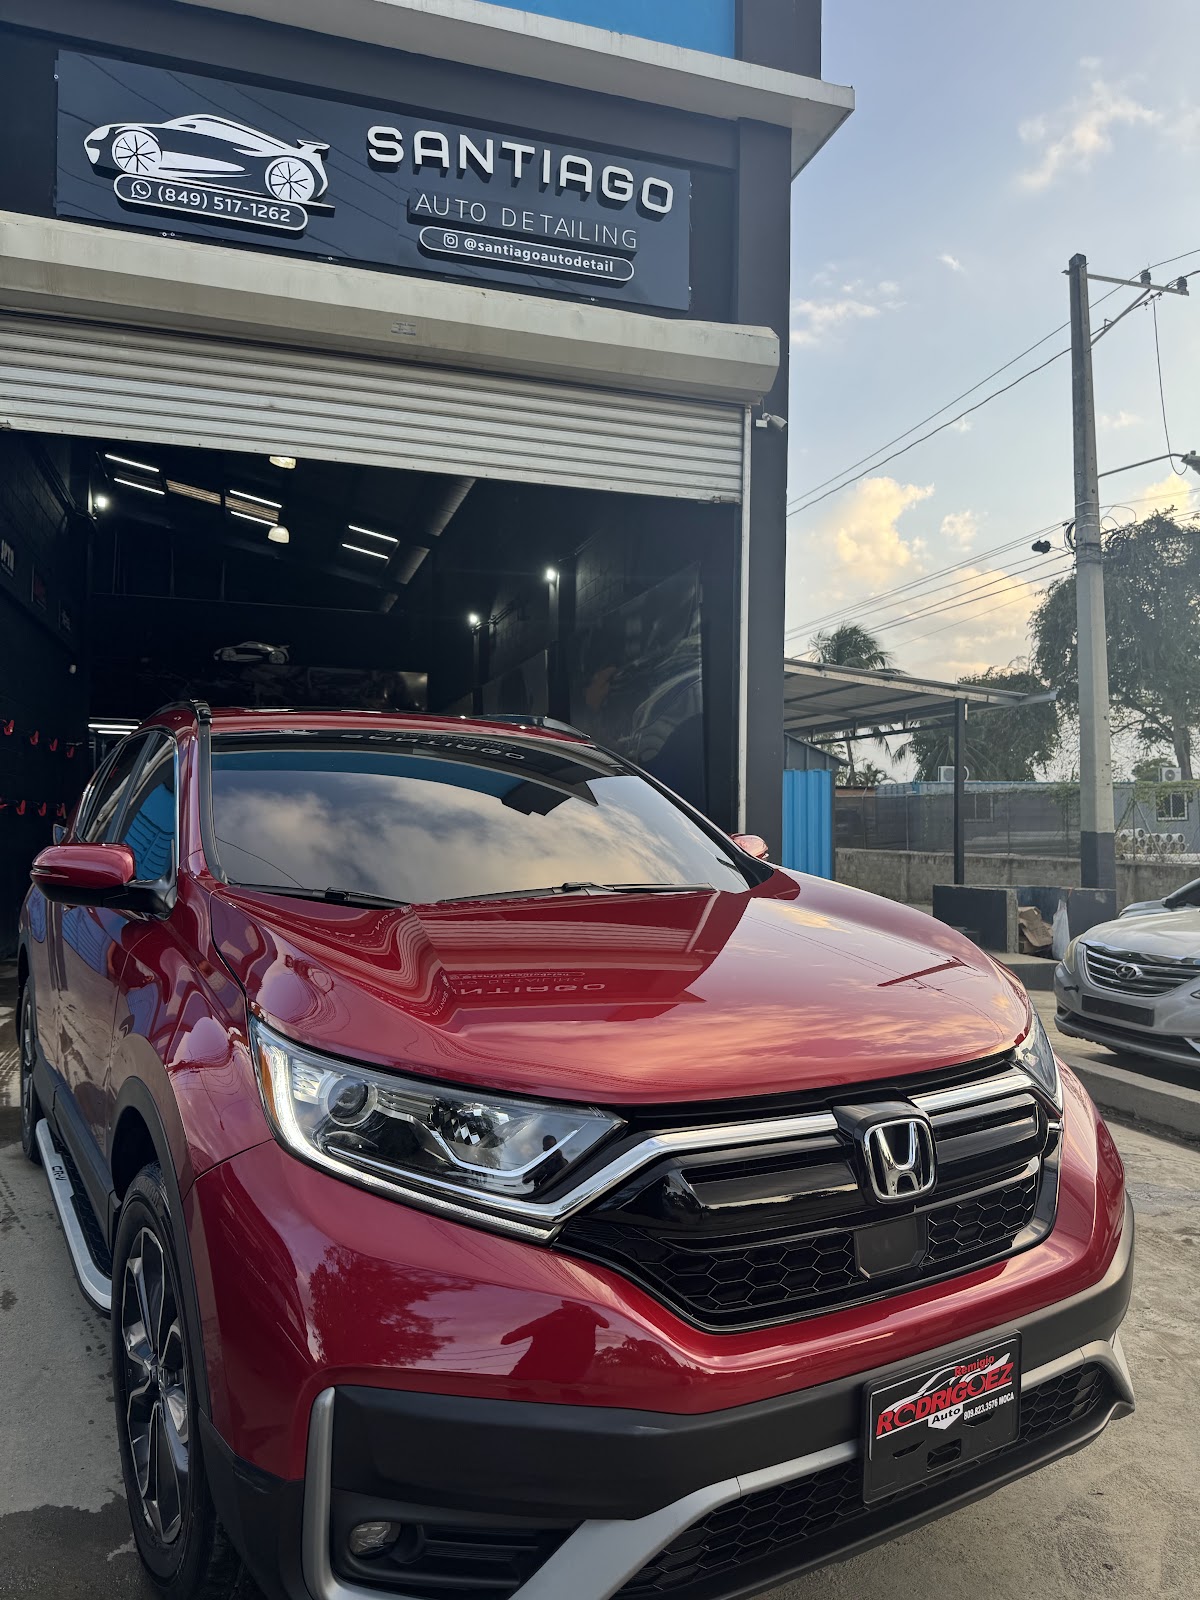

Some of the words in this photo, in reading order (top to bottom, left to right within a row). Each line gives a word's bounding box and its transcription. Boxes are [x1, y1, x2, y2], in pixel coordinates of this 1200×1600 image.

[367, 125, 674, 214] SANTIAGO
[157, 185, 208, 209] (849)
[213, 196, 291, 223] 517-1262
[414, 193, 487, 222] AUTO
[501, 207, 637, 249] DETAILING
[463, 237, 614, 273] @santiagoautodetail
[954, 1354, 995, 1378] Remigio
[931, 1408, 961, 1425] Auto
